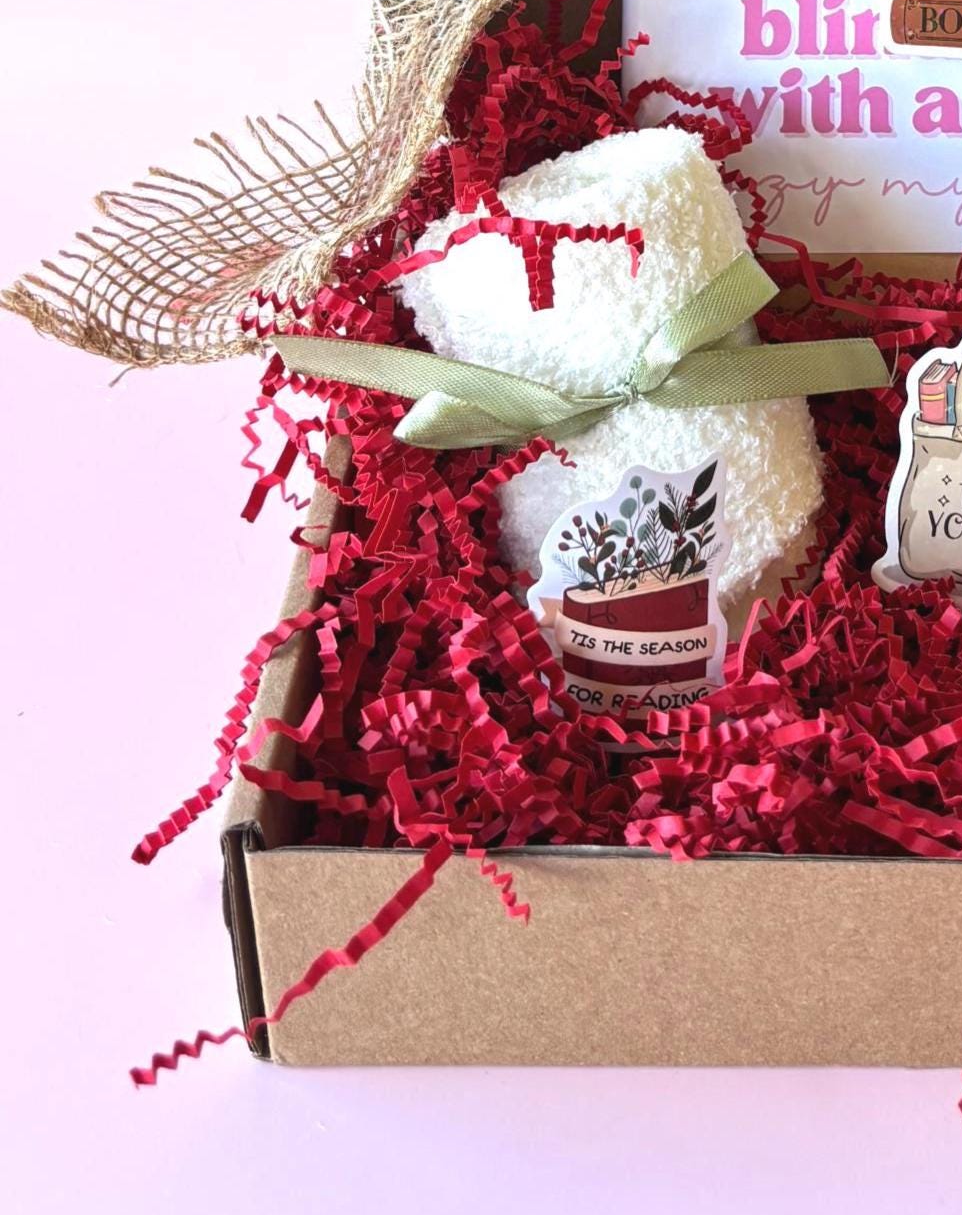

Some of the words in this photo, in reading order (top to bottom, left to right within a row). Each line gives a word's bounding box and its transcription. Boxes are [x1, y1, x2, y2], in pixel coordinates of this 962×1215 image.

[708, 67, 894, 136] with
[603, 640, 635, 655] THE
[639, 637, 708, 655] SEASON
[567, 684, 604, 706] FOR
